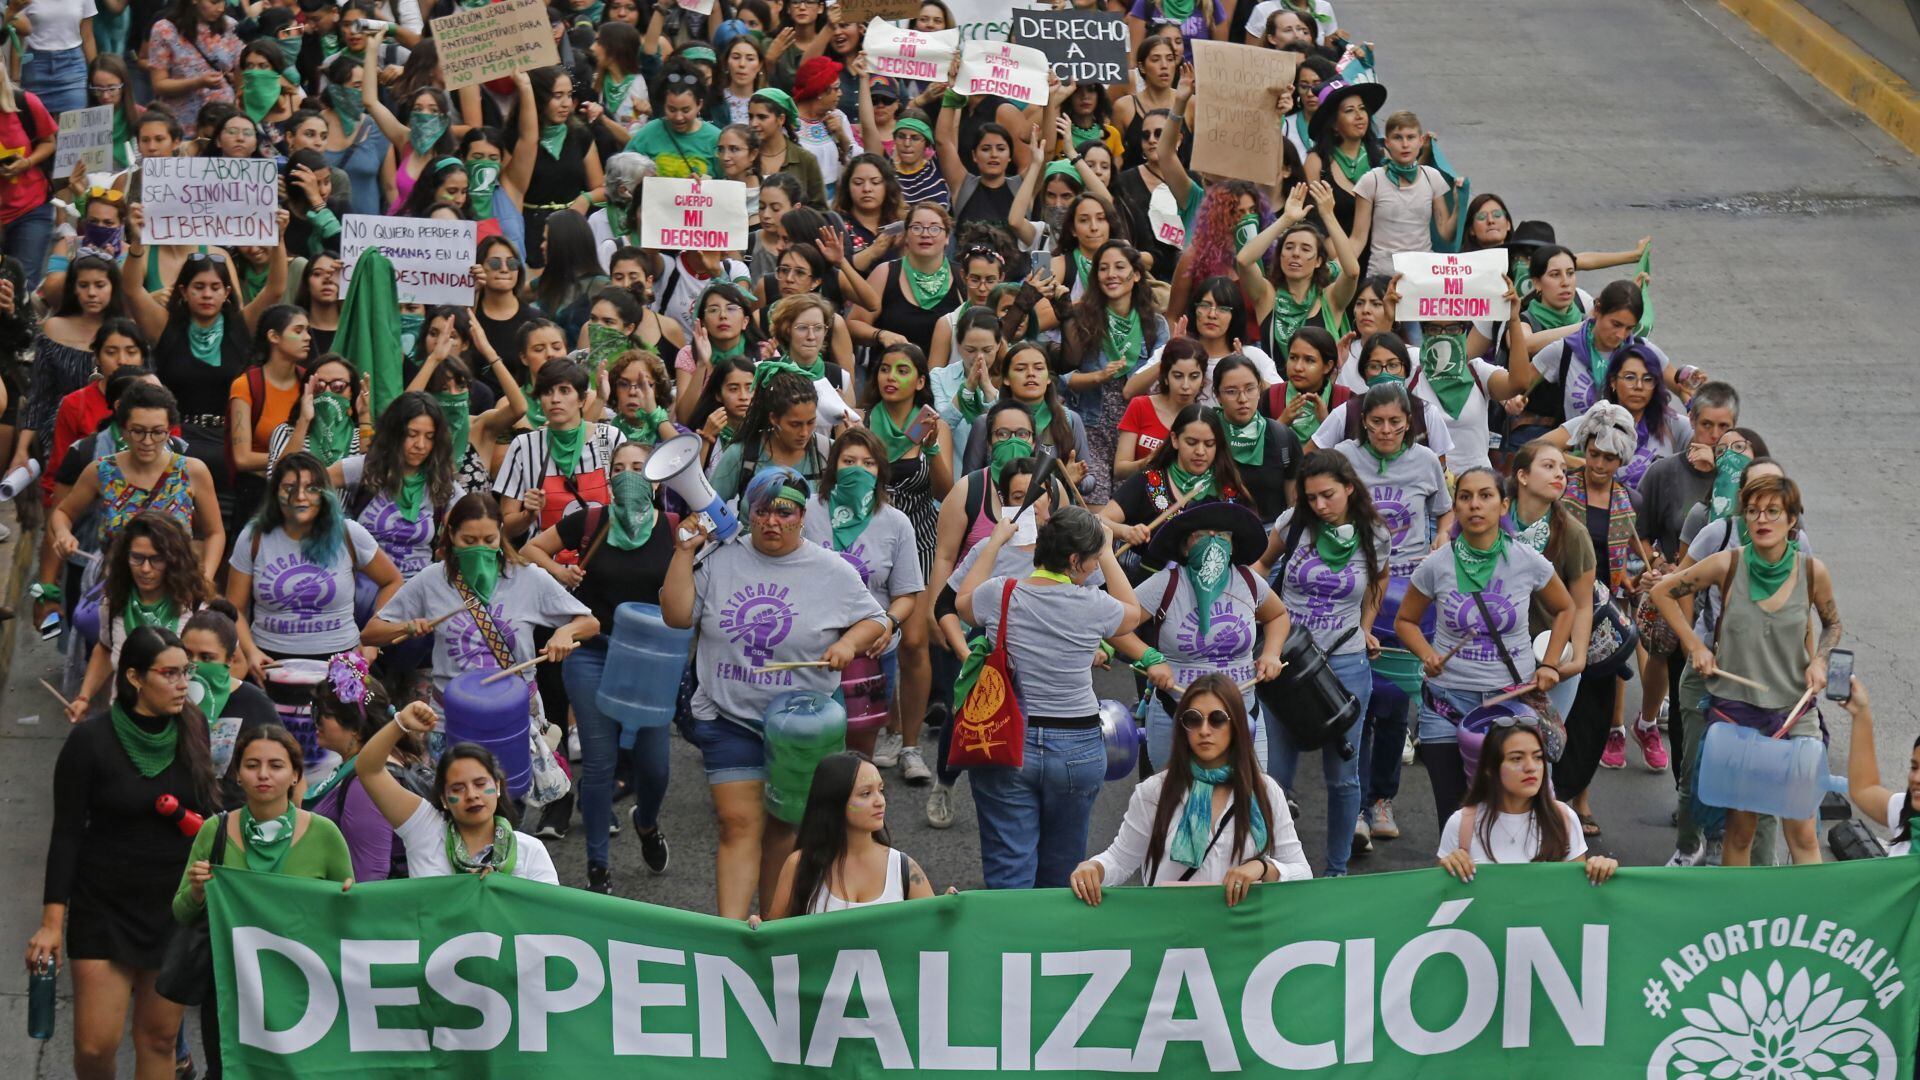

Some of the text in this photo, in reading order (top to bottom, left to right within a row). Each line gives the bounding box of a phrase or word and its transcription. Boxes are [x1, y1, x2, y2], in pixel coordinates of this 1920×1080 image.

[1019, 16, 1126, 41] DERECHO
[892, 36, 928, 45] CUERPO
[485, 48, 514, 63] LEGAL
[899, 44, 916, 58] MI
[1066, 42, 1086, 59] A
[453, 55, 533, 83] NO MORIR
[877, 56, 938, 79] DECISION
[984, 54, 1020, 70] CUERPO
[1048, 61, 1123, 81] CIDIR
[991, 66, 1009, 80] MI
[970, 79, 1031, 101] DECISION
[144, 157, 277, 184] QUE EL ABORTO
[144, 184, 176, 202] SEA
[674, 195, 713, 207] CUERPO
[190, 202, 216, 214] DE
[150, 211, 273, 240] LIBERACIÓN
[684, 209, 703, 227] MI
[345, 219, 472, 240] NO QUIERO PERDER A
[660, 228, 729, 248] DECISION
[436, 249, 452, 260] EN
[456, 250, 470, 260] LA
[1447, 255, 1458, 265] MI
[1431, 265, 1472, 276] CUERPO
[1444, 278, 1463, 295] MI
[1419, 298, 1490, 317] DECISION
[719, 582, 790, 629] BATUCADA
[717, 662, 793, 686] FEMINISTA
[1643, 914, 1905, 1020] #ABORTOLEGALYA
[233, 898, 1609, 1073] DESPENALIZACIÓN
